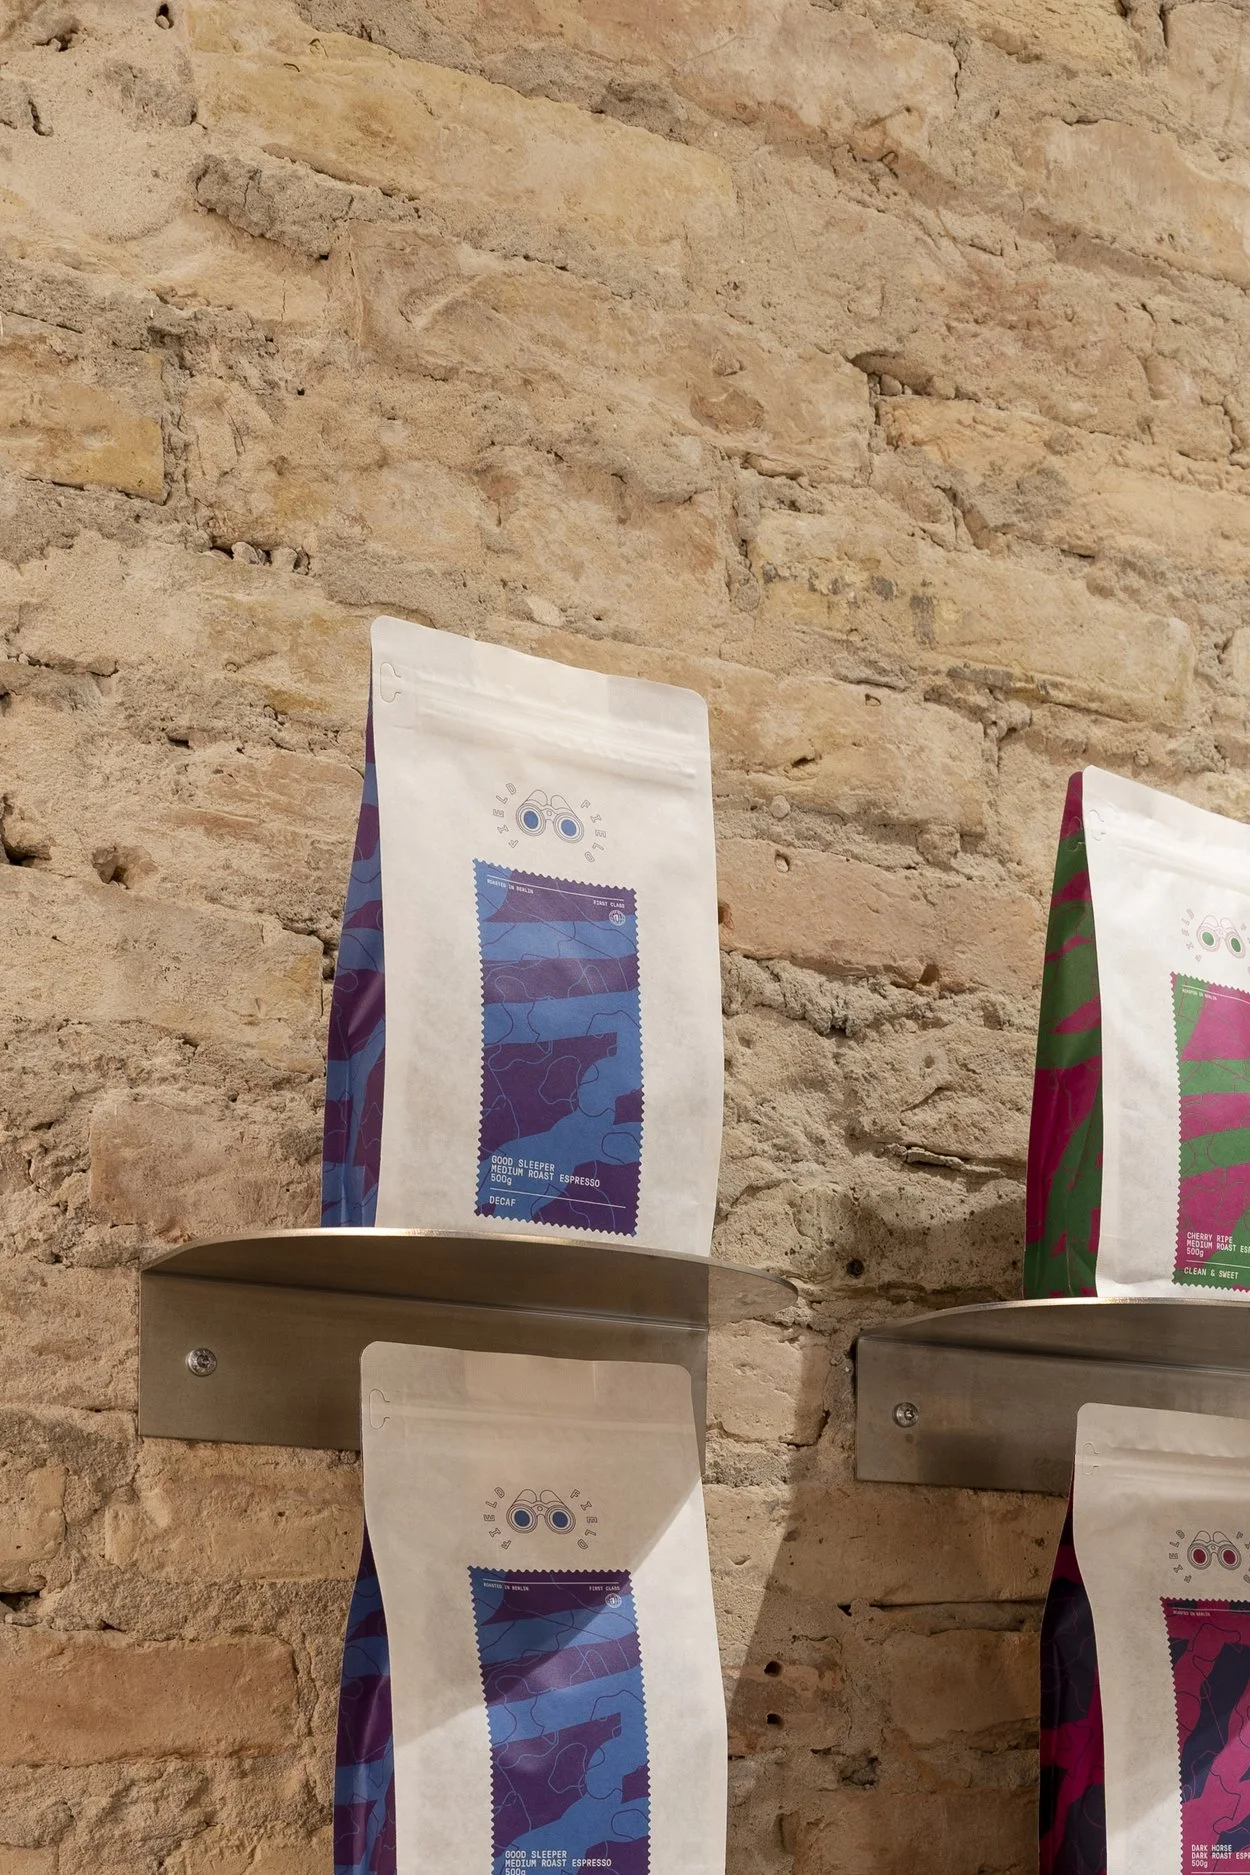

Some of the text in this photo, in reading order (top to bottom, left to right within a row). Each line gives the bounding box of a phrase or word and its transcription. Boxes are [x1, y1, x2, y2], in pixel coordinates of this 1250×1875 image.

[493, 782, 519, 849] FIELD
[580, 799, 607, 863] FIELD
[492, 1155, 555, 1171] GOOD SLEEPER
[491, 1164, 600, 1187] MEDIUM ROAST ESPRESSO
[491, 1173, 512, 1185] 500g
[489, 1196, 516, 1207] DECAF
[1187, 1232, 1212, 1240] CHERRY
[1187, 1240, 1212, 1249] MEDIUM
[1217, 1242, 1236, 1252] ROAST
[1186, 1248, 1204, 1257] 500g
[1184, 1267, 1207, 1276] CLEAN
[1219, 1271, 1239, 1279] SWEET
[483, 1487, 512, 1549] FIELD
[570, 1489, 598, 1549] FIELD
[1169, 1530, 1192, 1583] FIELD
[505, 1859, 611, 1867] MEDIUM ROAST ESPRESSO
[1192, 1860, 1208, 1868] 500g
